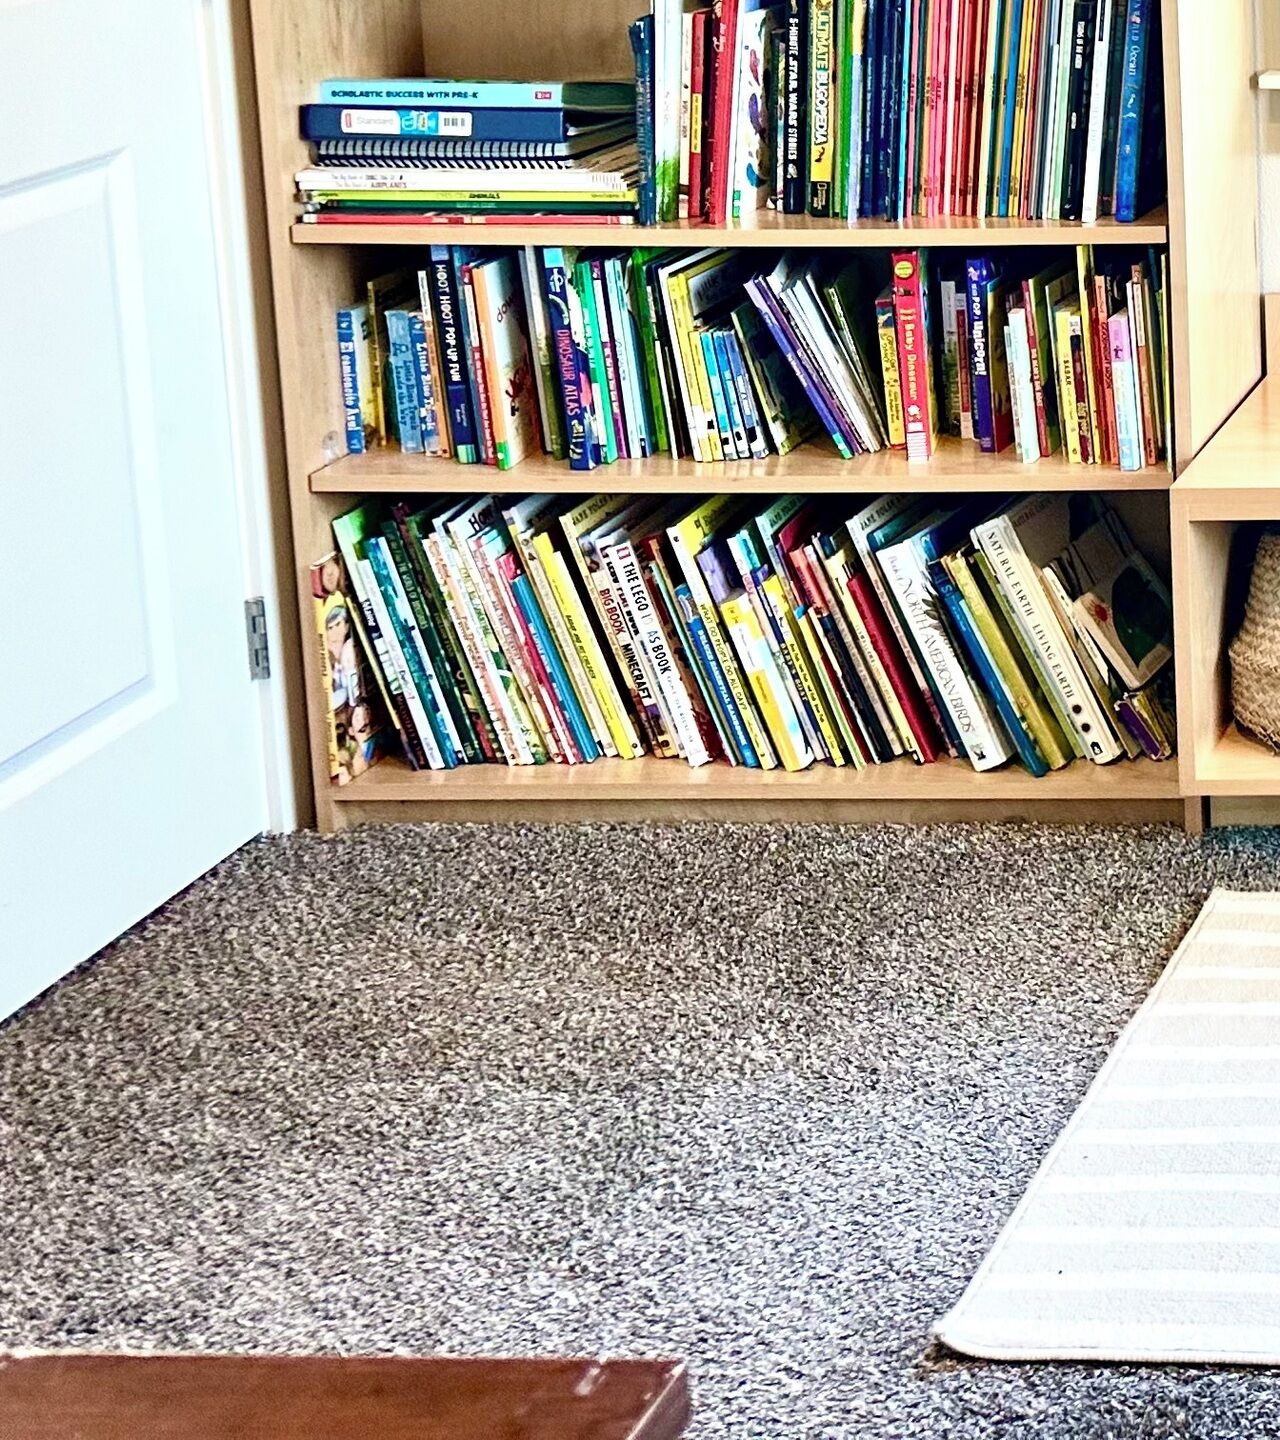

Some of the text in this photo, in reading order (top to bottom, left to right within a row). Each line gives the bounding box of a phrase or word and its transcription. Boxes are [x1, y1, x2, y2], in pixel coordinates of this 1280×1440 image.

[788, 18, 799, 55] 5-MINUTE
[788, 57, 798, 91] STAR
[815, 10, 831, 145] ULTIMATE BUGOPEDIA
[1128, 45, 1140, 76] Ocean
[788, 92, 798, 127] WARS
[435, 264, 461, 382] HOOT HOOT POP-UP FUN
[972, 297, 981, 315] POP
[340, 341, 361, 431] El camioncito Azul
[416, 342, 433, 397] Little Blue
[556, 329, 581, 416] DINOSAUR ATLAS
[904, 323, 918, 400] Baby Dinosaur
[973, 320, 987, 375] Unicorn!
[600, 589, 652, 700] BIG BOOK MINECRAFT
[622, 562, 672, 675] THE LEGO BOOK
[900, 579, 973, 733] NORTH AMERICAN BIRDS
[986, 531, 1074, 699] NATURAL EARTH LIVING EARTH
